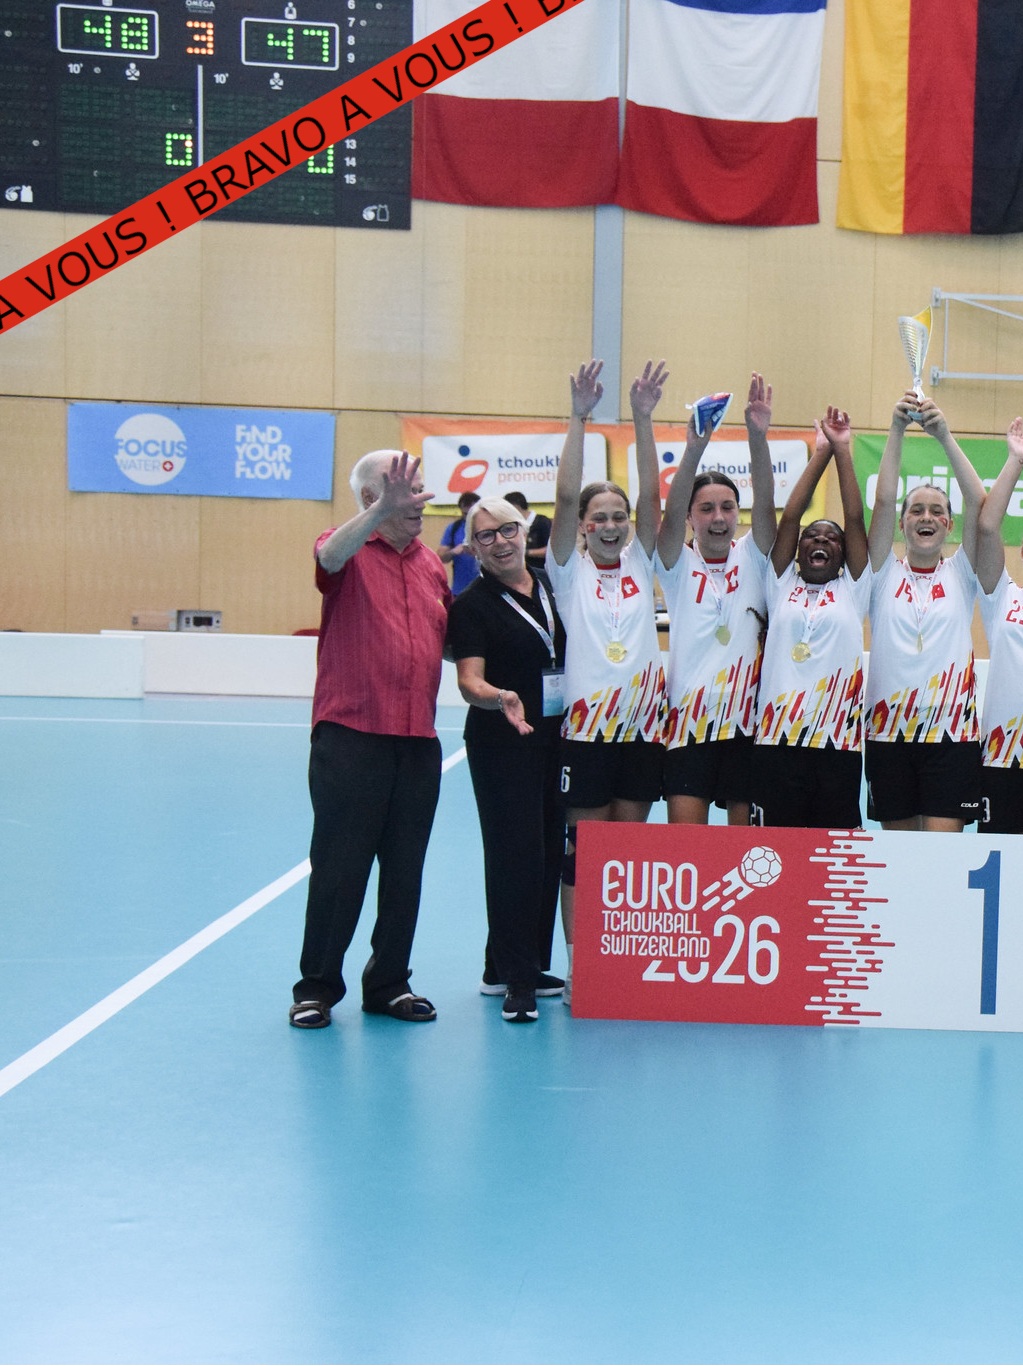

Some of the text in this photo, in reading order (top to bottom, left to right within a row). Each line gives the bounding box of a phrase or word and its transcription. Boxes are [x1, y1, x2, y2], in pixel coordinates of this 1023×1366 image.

[84, 15, 148, 51] 48
[347, 17, 356, 27] 7
[186, 21, 214, 55] 3
[267, 28, 329, 62] 47
[347, 35, 355, 45] 8
[347, 53, 355, 63] 9
[344, 140, 356, 149] 13
[344, 157, 356, 167] 14
[344, 174, 356, 184] 15
[235, 444, 292, 463] YOUR
[692, 571, 707, 604] 7
[601, 860, 698, 912] EURO
[601, 910, 702, 935] TCHOUKBALL
[967, 850, 1001, 1016] 1
[600, 933, 711, 961] SWITZERLAND
